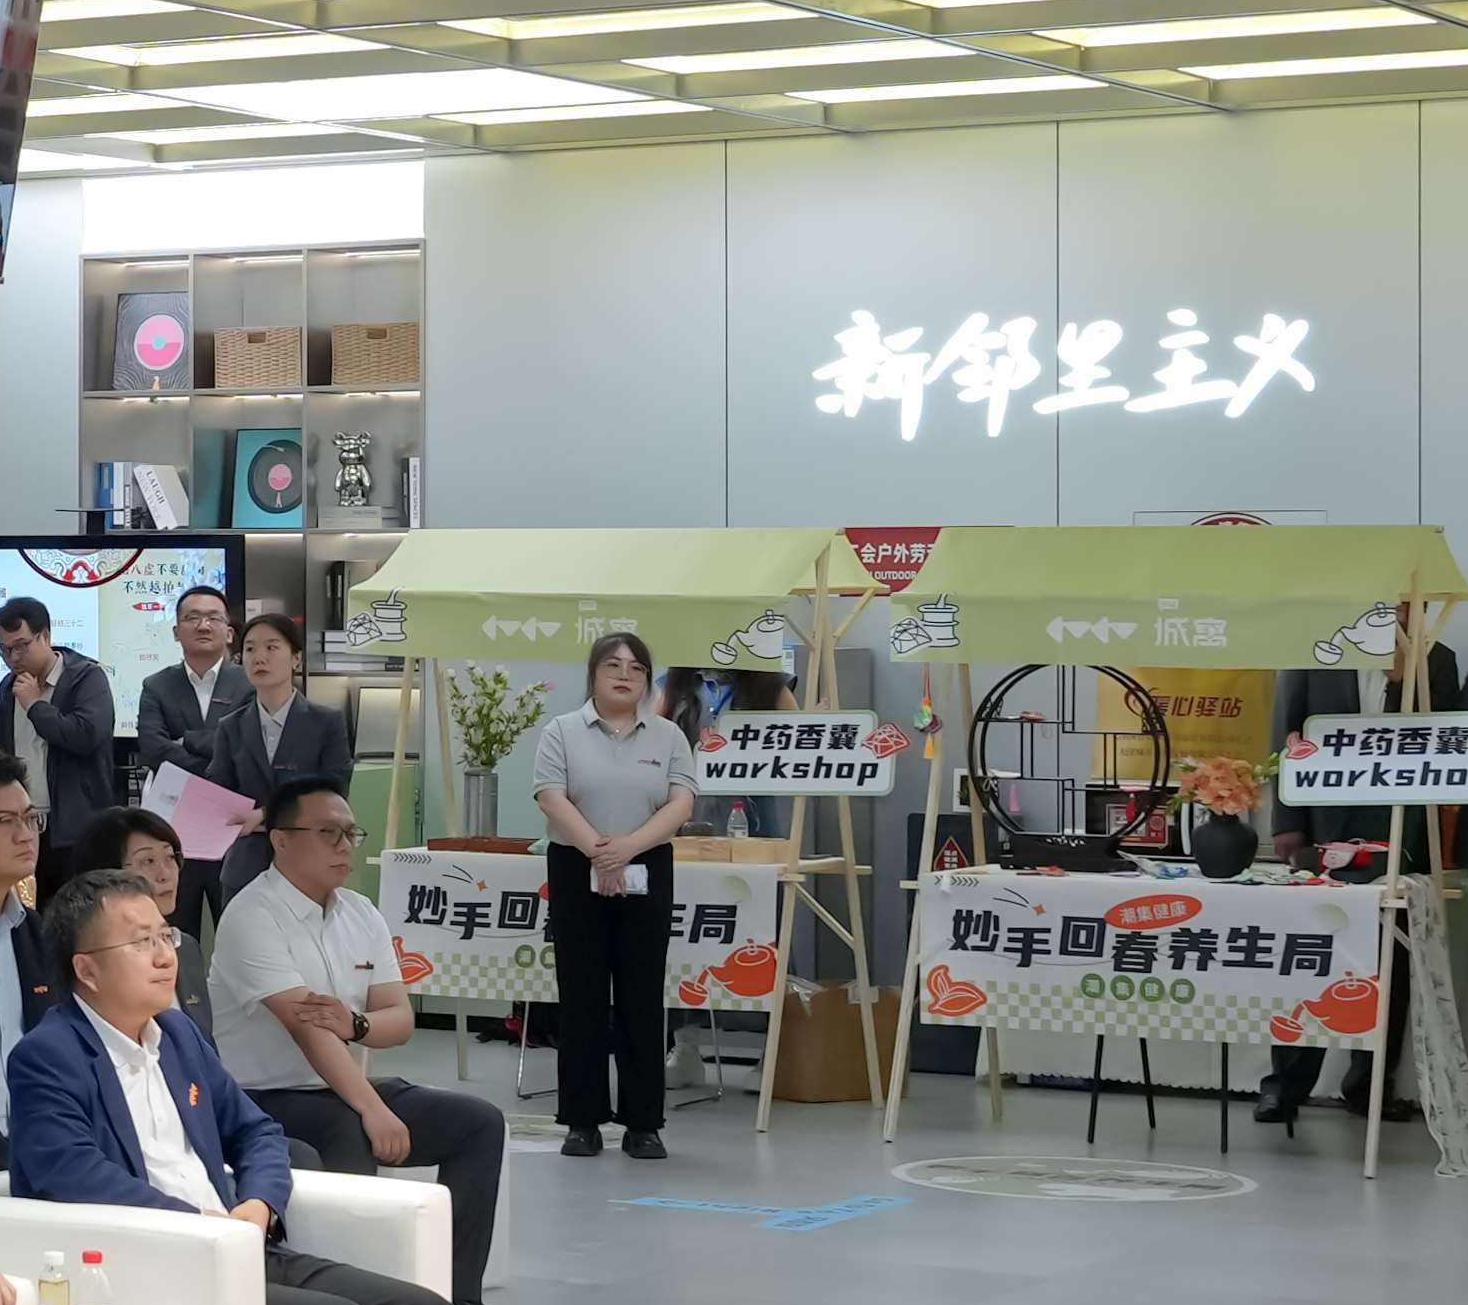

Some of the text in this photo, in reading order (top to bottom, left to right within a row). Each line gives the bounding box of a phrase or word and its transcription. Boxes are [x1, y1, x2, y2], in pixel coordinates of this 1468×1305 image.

[730, 723, 861, 751] 中药香囊
[706, 756, 879, 786] workshop
[949, 908, 1334, 977] 妙手回春养生局
